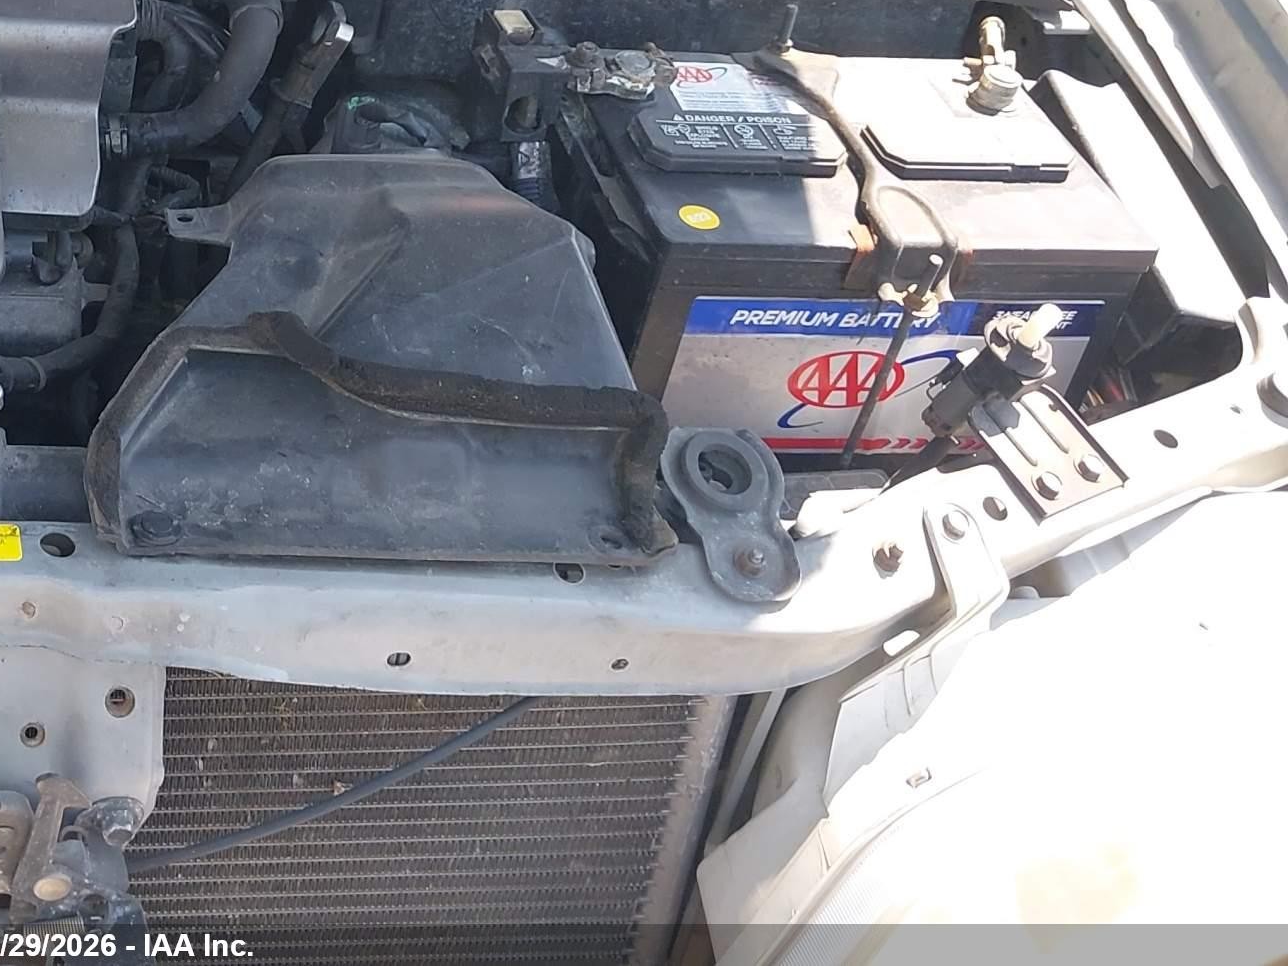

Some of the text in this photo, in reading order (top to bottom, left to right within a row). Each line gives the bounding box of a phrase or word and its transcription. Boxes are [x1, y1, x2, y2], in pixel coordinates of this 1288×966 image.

[684, 114, 735, 123] DANGER
[745, 116, 792, 124] POISON
[730, 310, 834, 328] PREMIUM
[794, 351, 896, 408] AAA
